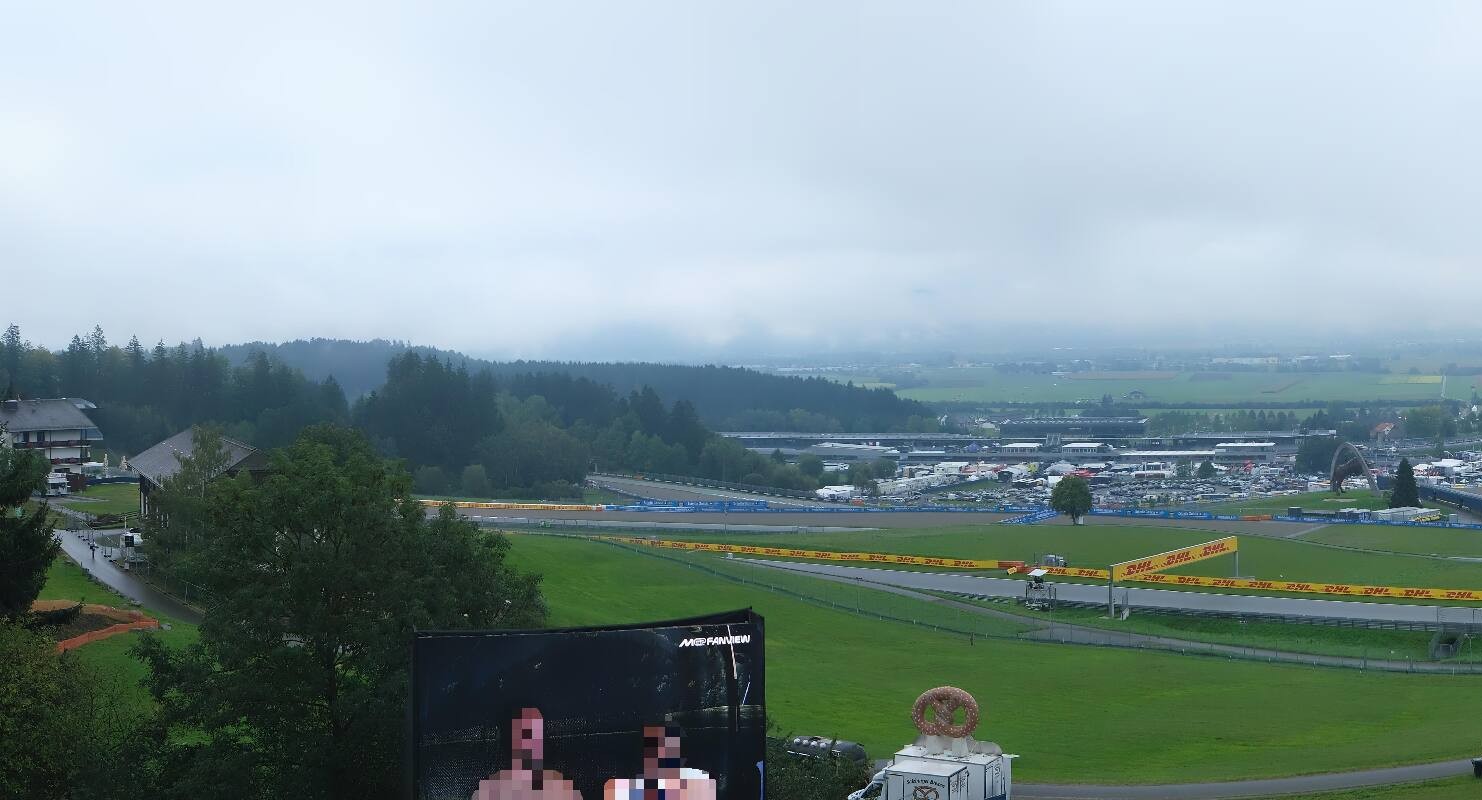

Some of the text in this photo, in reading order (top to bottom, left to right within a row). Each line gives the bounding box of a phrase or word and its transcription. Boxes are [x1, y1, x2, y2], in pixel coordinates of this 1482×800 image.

[1203, 542, 1226, 555] DHL
[1166, 552, 1191, 565] DHL
[1046, 567, 1068, 575] DHL
[1125, 560, 1153, 575] DHL
[1077, 569, 1100, 577] DHL
[1143, 574, 1166, 582] DHL
[1177, 576, 1200, 584] DHL
[1286, 583, 1312, 591] DHL
[1324, 585, 1351, 593] DHL
[1363, 587, 1390, 595] DHL
[1404, 589, 1432, 597] DHL
[707, 635, 750, 645] FANVIEW
